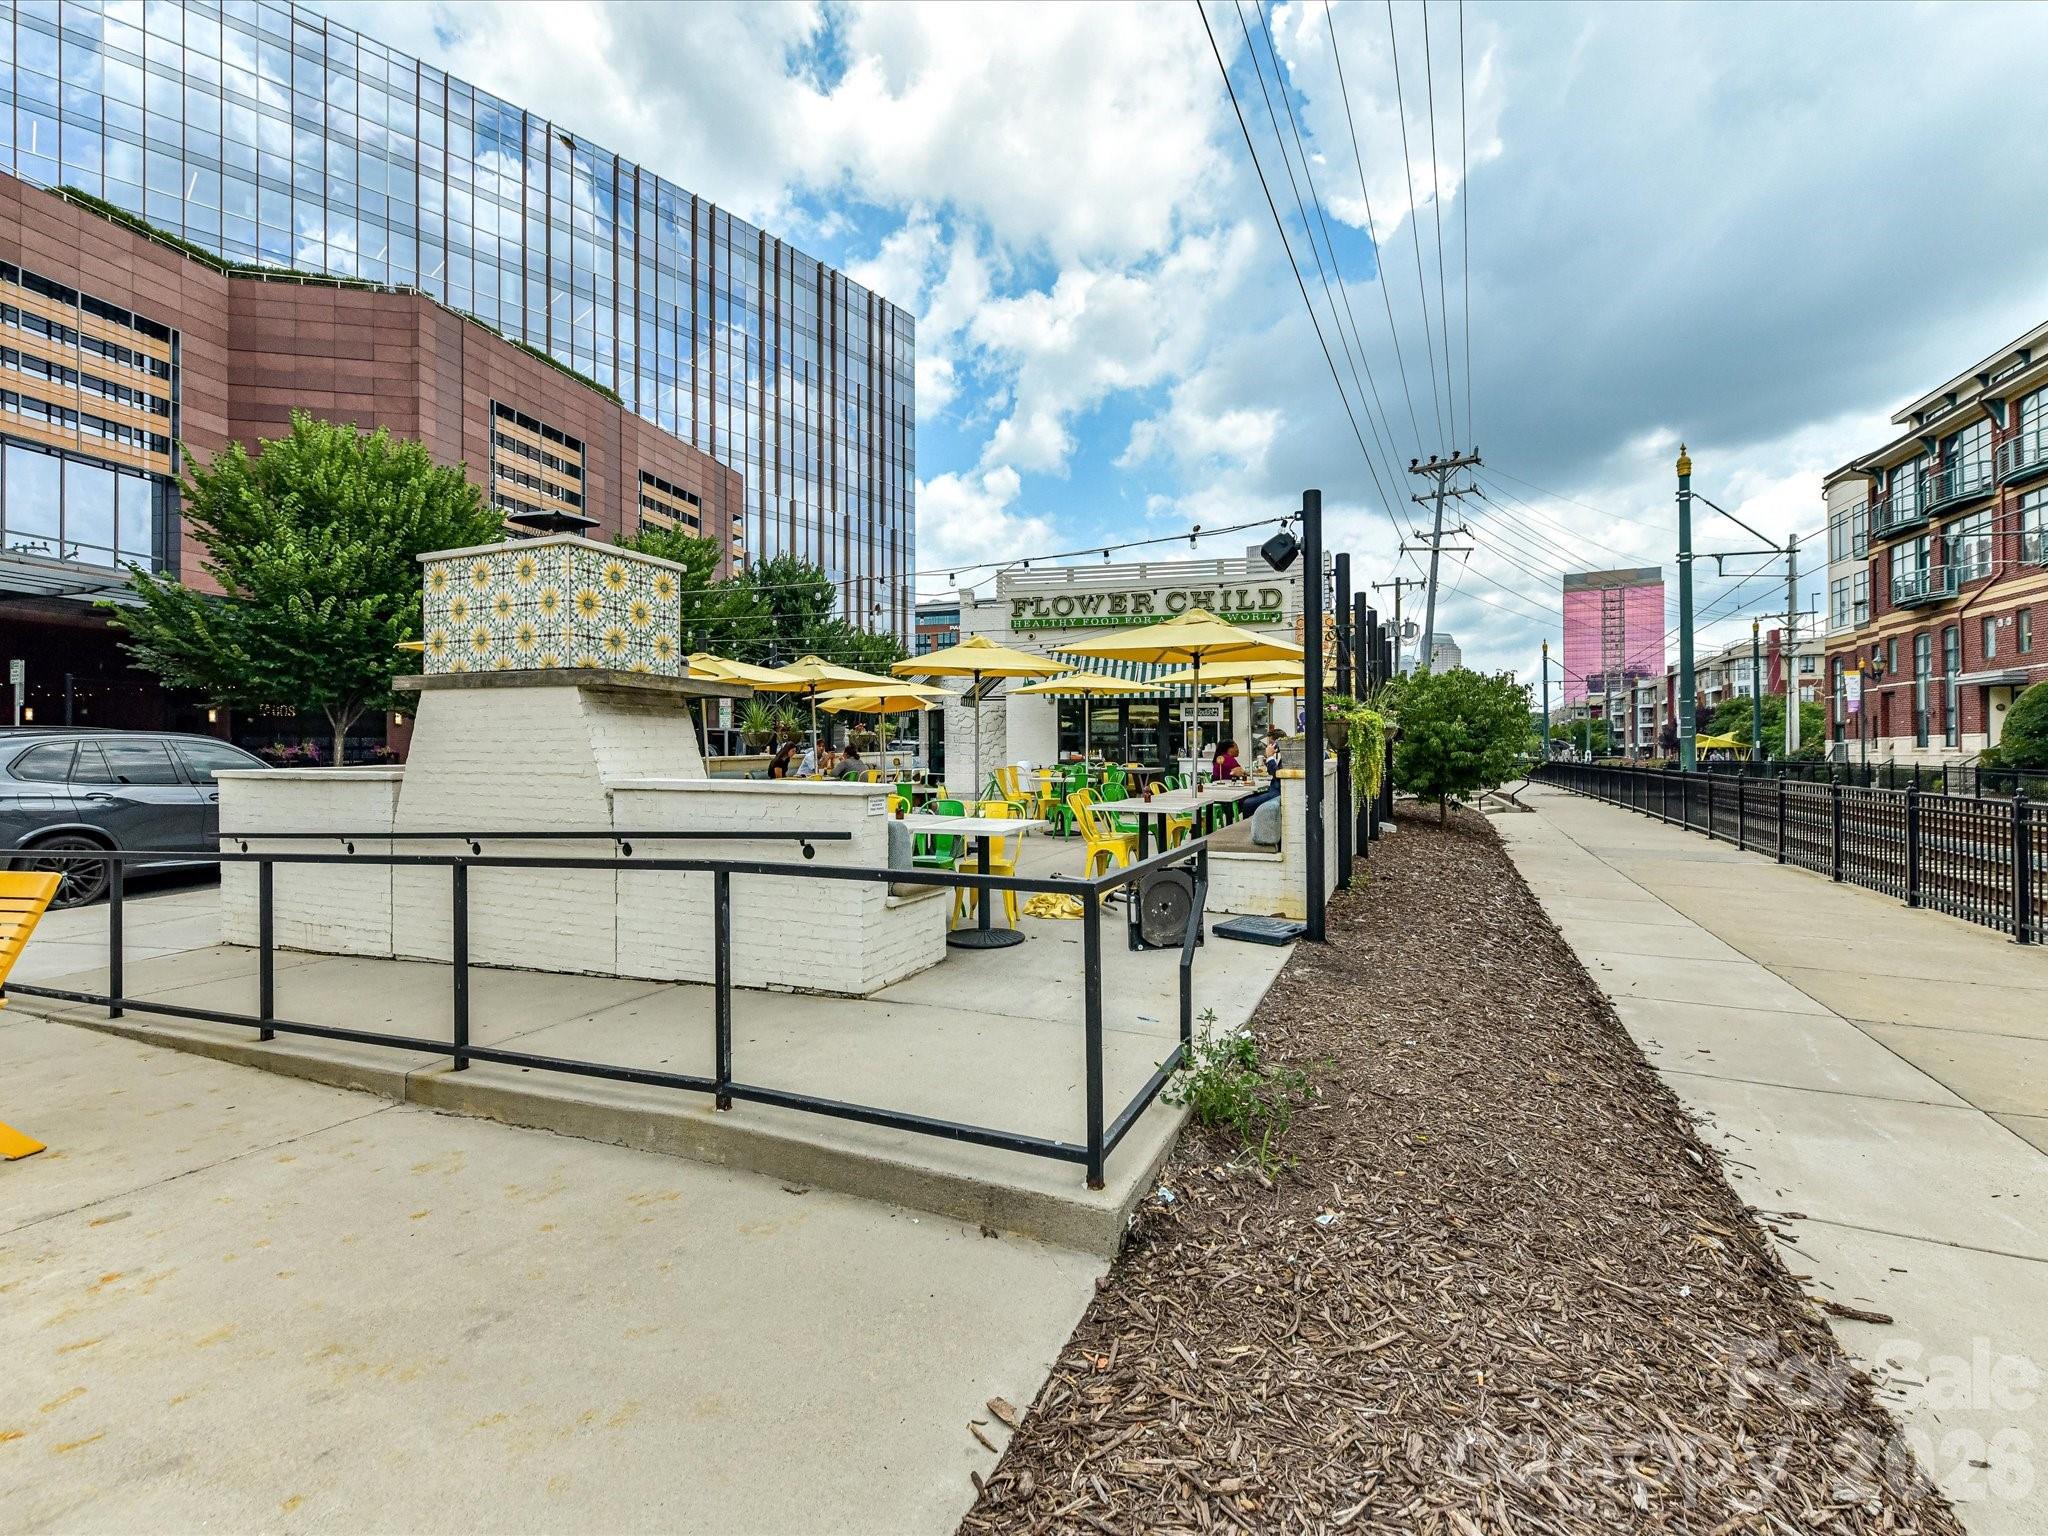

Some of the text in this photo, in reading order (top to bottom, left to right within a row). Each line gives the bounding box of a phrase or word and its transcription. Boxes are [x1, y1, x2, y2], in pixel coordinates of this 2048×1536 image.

[1011, 588, 1283, 617] FLOWER CHILD
[1013, 618, 1077, 628] HEALTHY
[1082, 617, 1119, 627] FOOD
[1125, 616, 1152, 625] FOR
